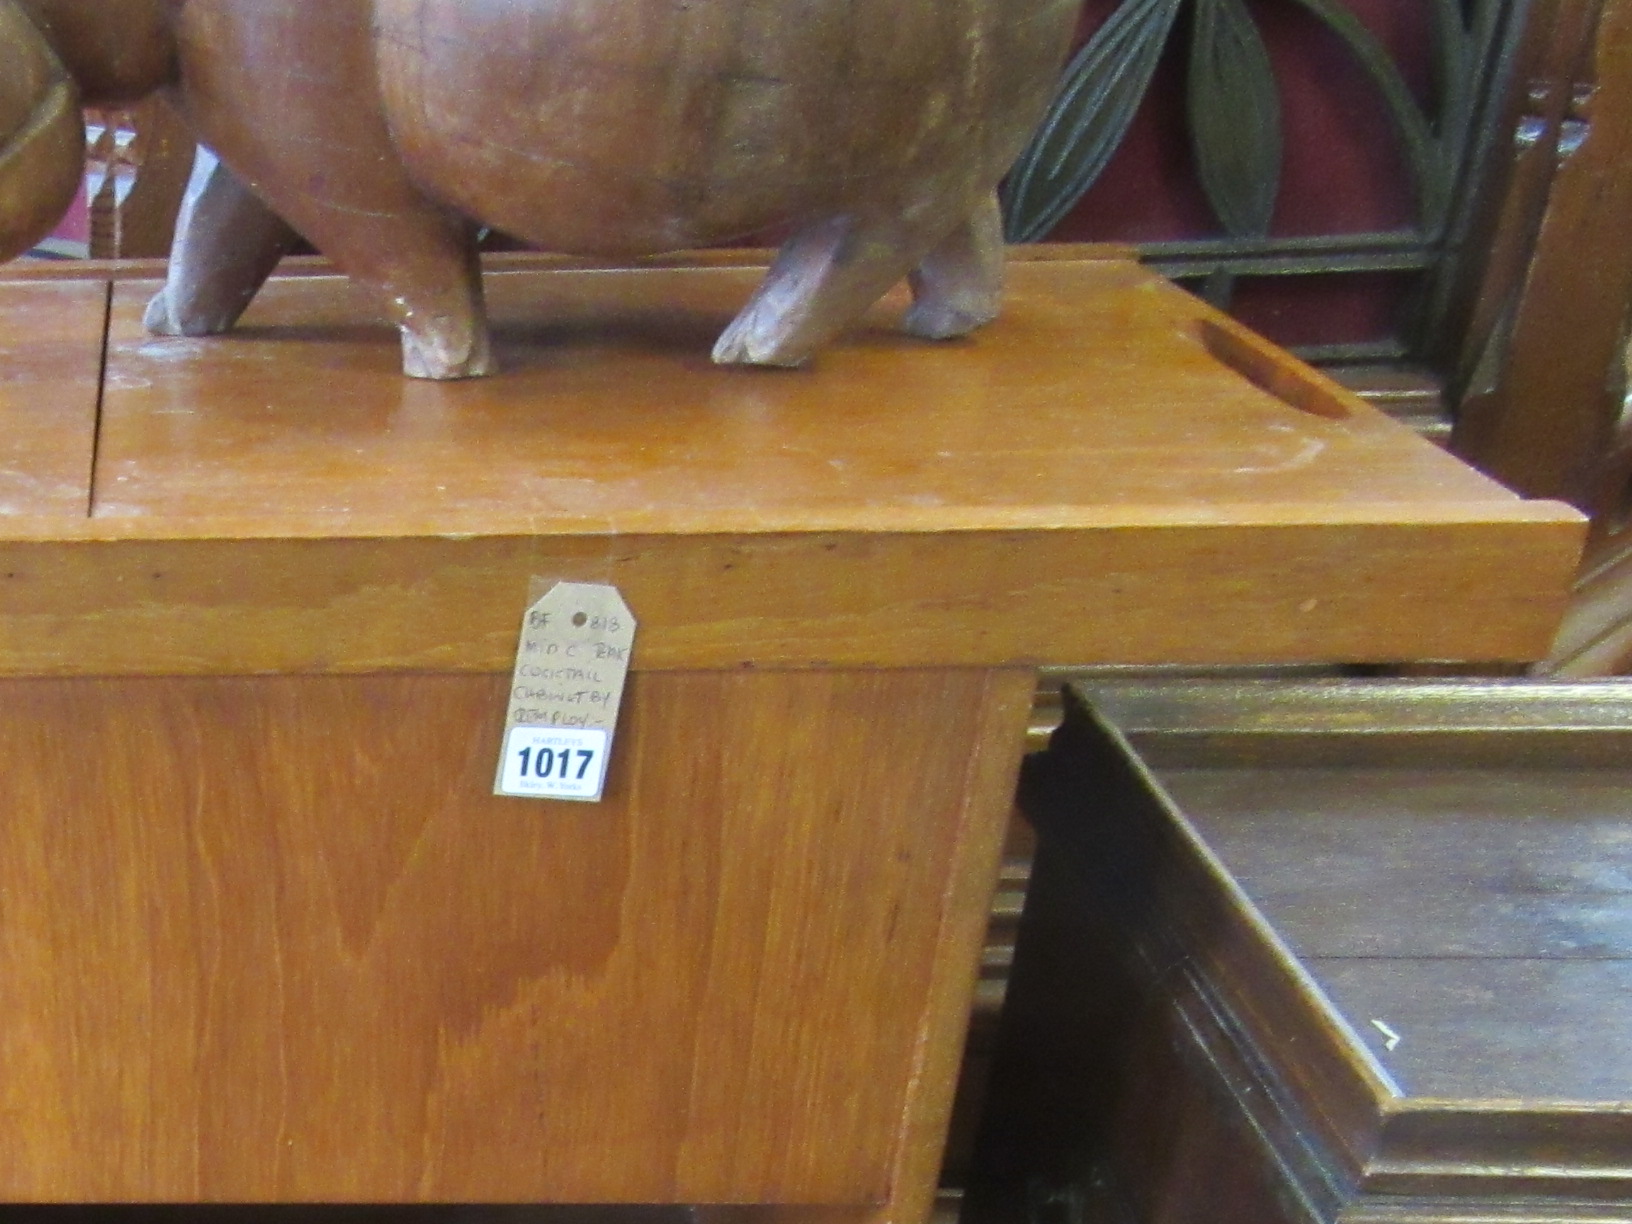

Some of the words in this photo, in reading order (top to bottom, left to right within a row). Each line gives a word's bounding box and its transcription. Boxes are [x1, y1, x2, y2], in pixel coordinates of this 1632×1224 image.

[519, 664, 602, 682] COCKTAIL
[590, 690, 612, 708] BY
[517, 746, 595, 780] 1017
